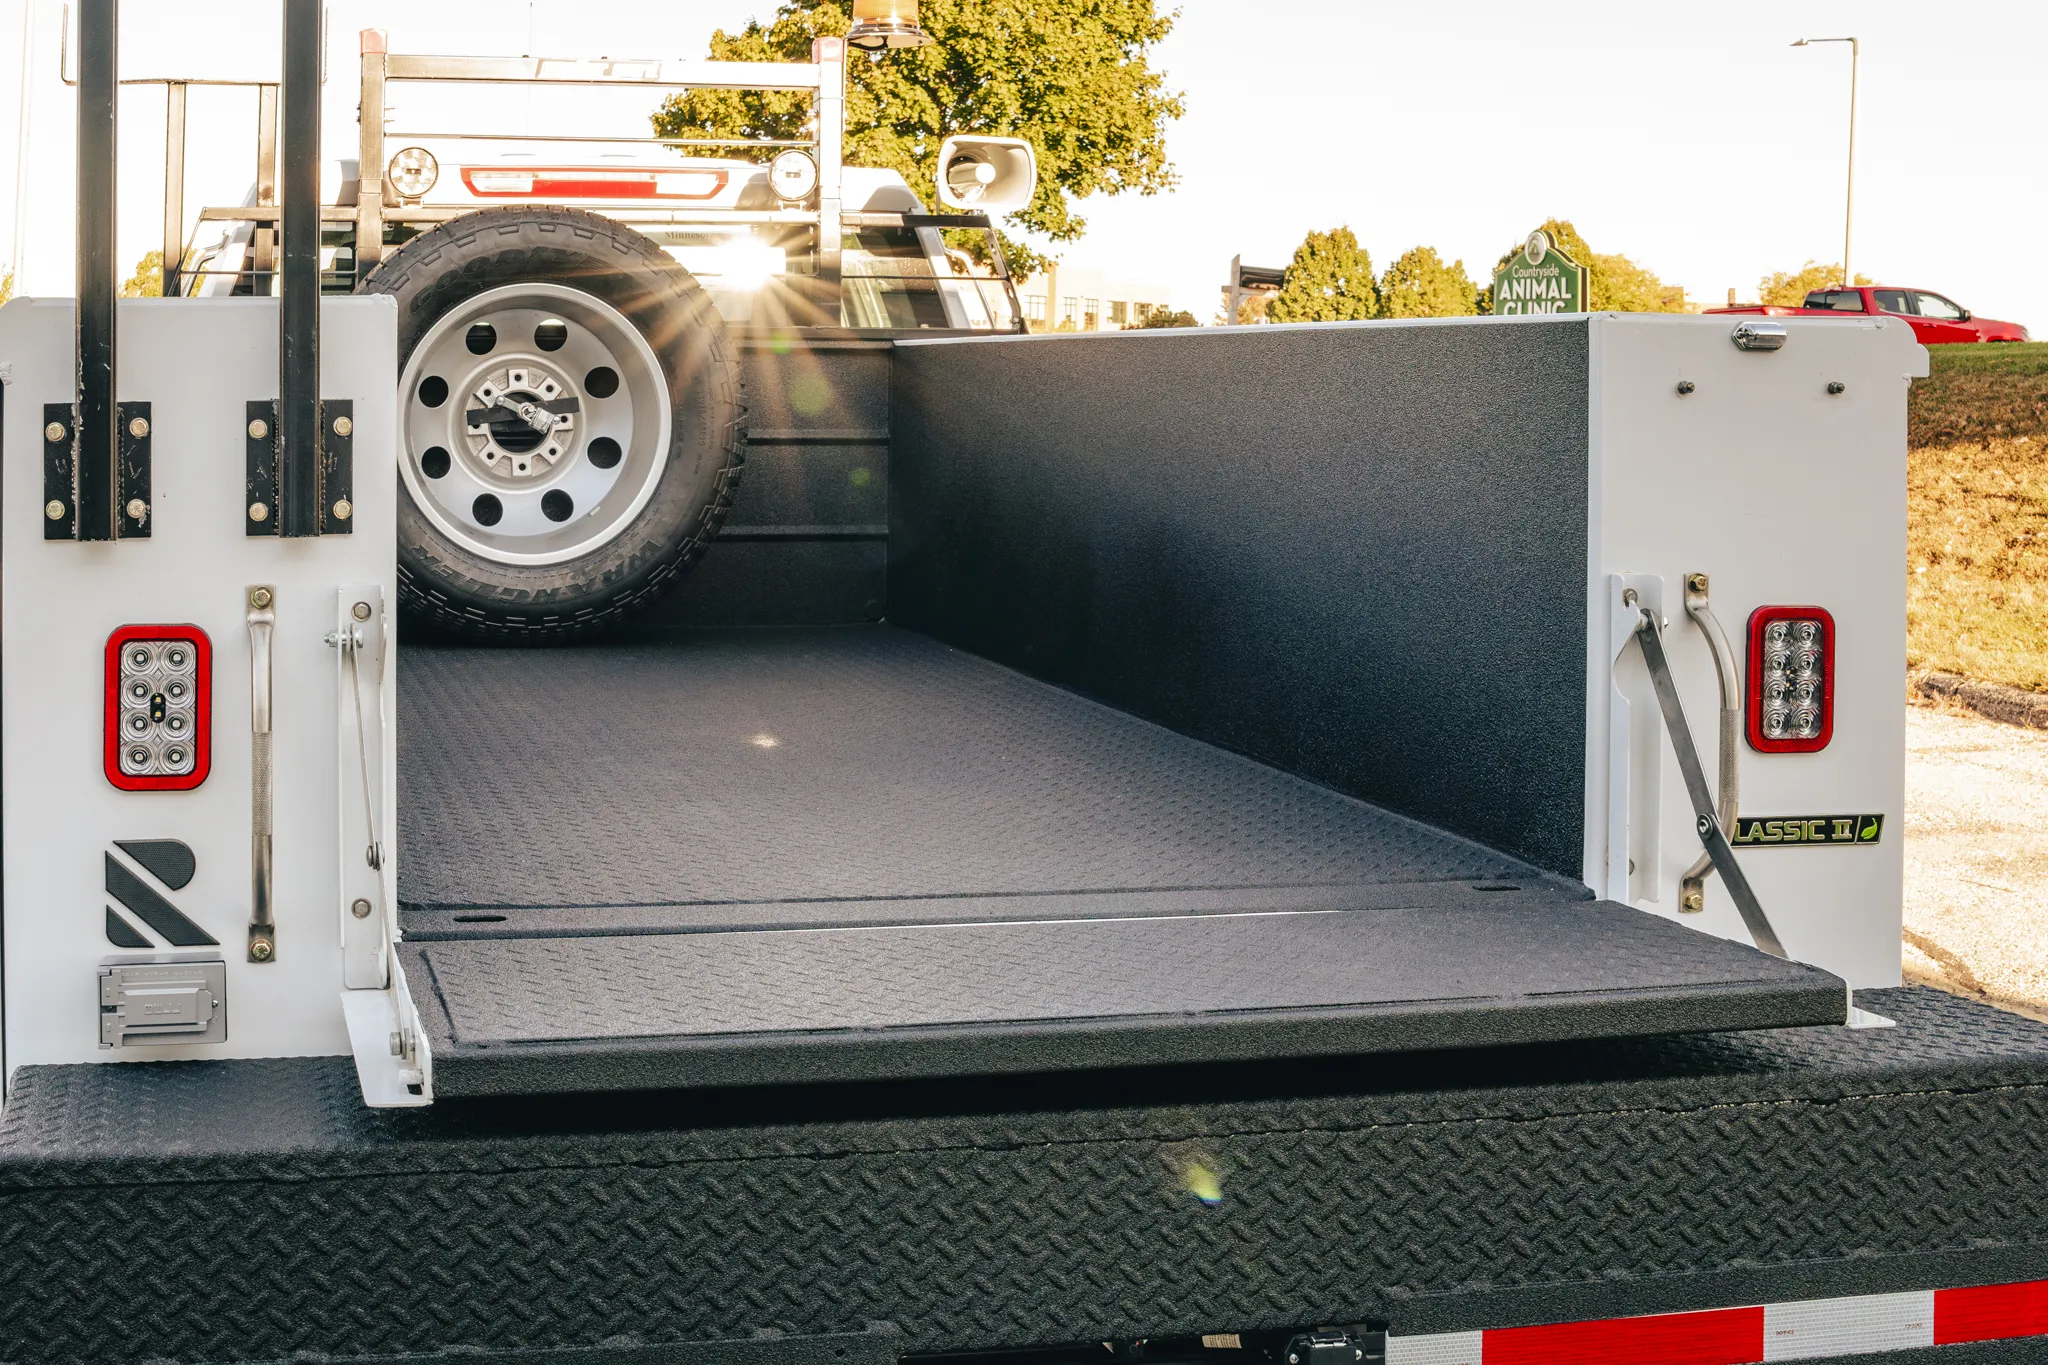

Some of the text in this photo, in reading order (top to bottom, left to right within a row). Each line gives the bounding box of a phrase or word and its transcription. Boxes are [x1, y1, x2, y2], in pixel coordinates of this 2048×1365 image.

[1512, 263, 1560, 280] Countryside
[1499, 276, 1572, 301] ANIMAL
[1735, 819, 1853, 842] LASSIC II
